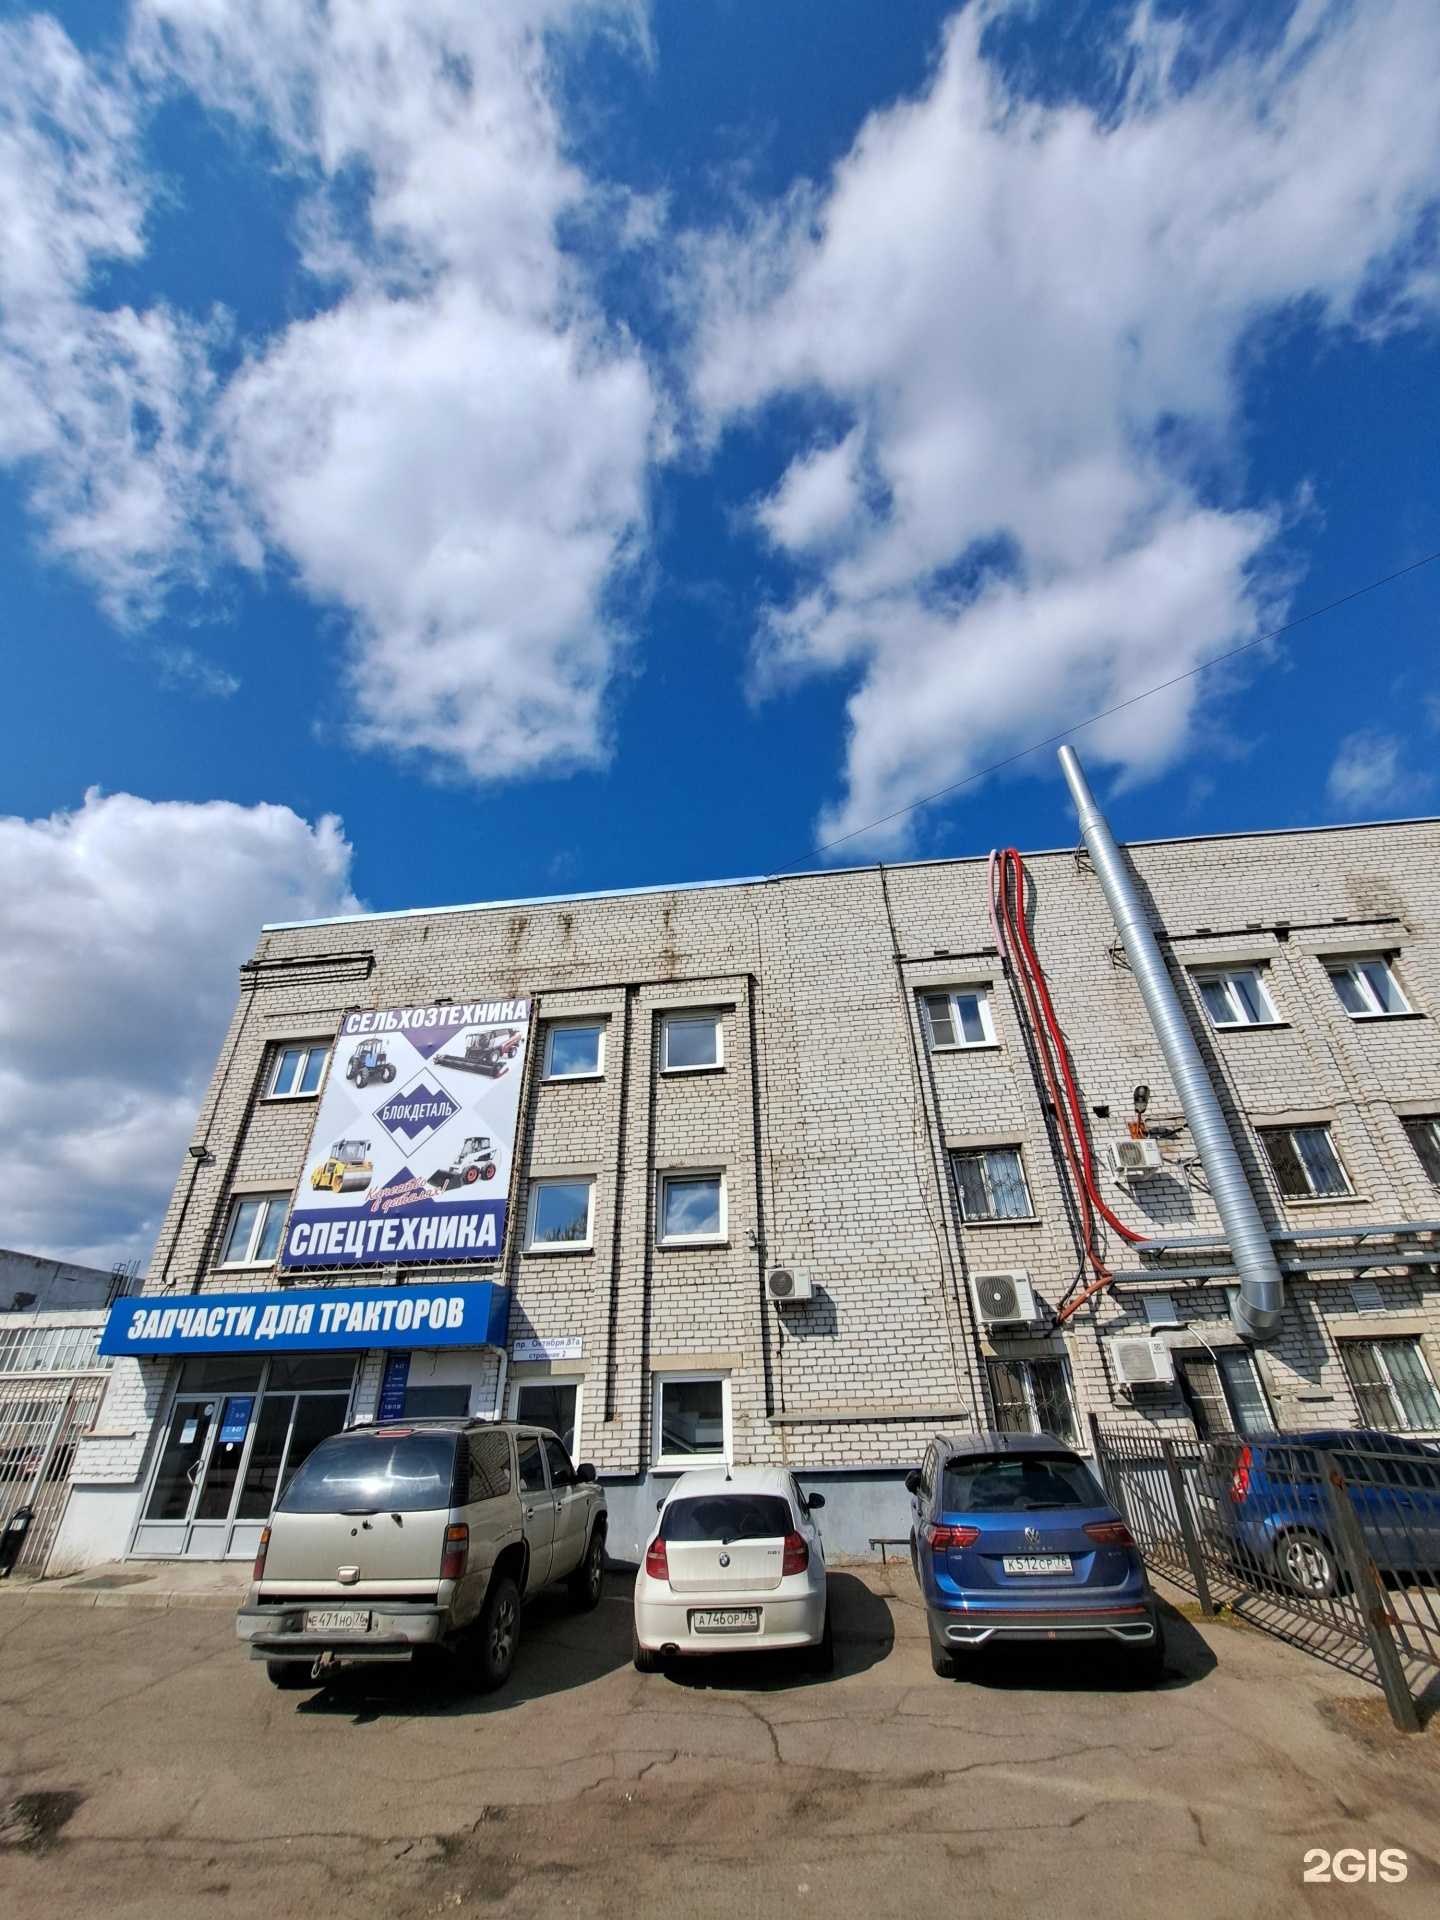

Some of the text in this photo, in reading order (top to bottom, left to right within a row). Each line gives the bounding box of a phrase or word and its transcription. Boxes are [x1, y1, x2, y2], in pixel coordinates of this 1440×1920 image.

[346, 1000, 527, 1033] СЕЛЬХОЗТЕХНИКА
[382, 1102, 452, 1122] БЛОКДЕТАЛЬ
[289, 1213, 496, 1258] СПЕЦТЕХНИКА
[127, 1297, 465, 1340] ЗАПЧАСТИ ДЛЯ ТРАКТОРОВ
